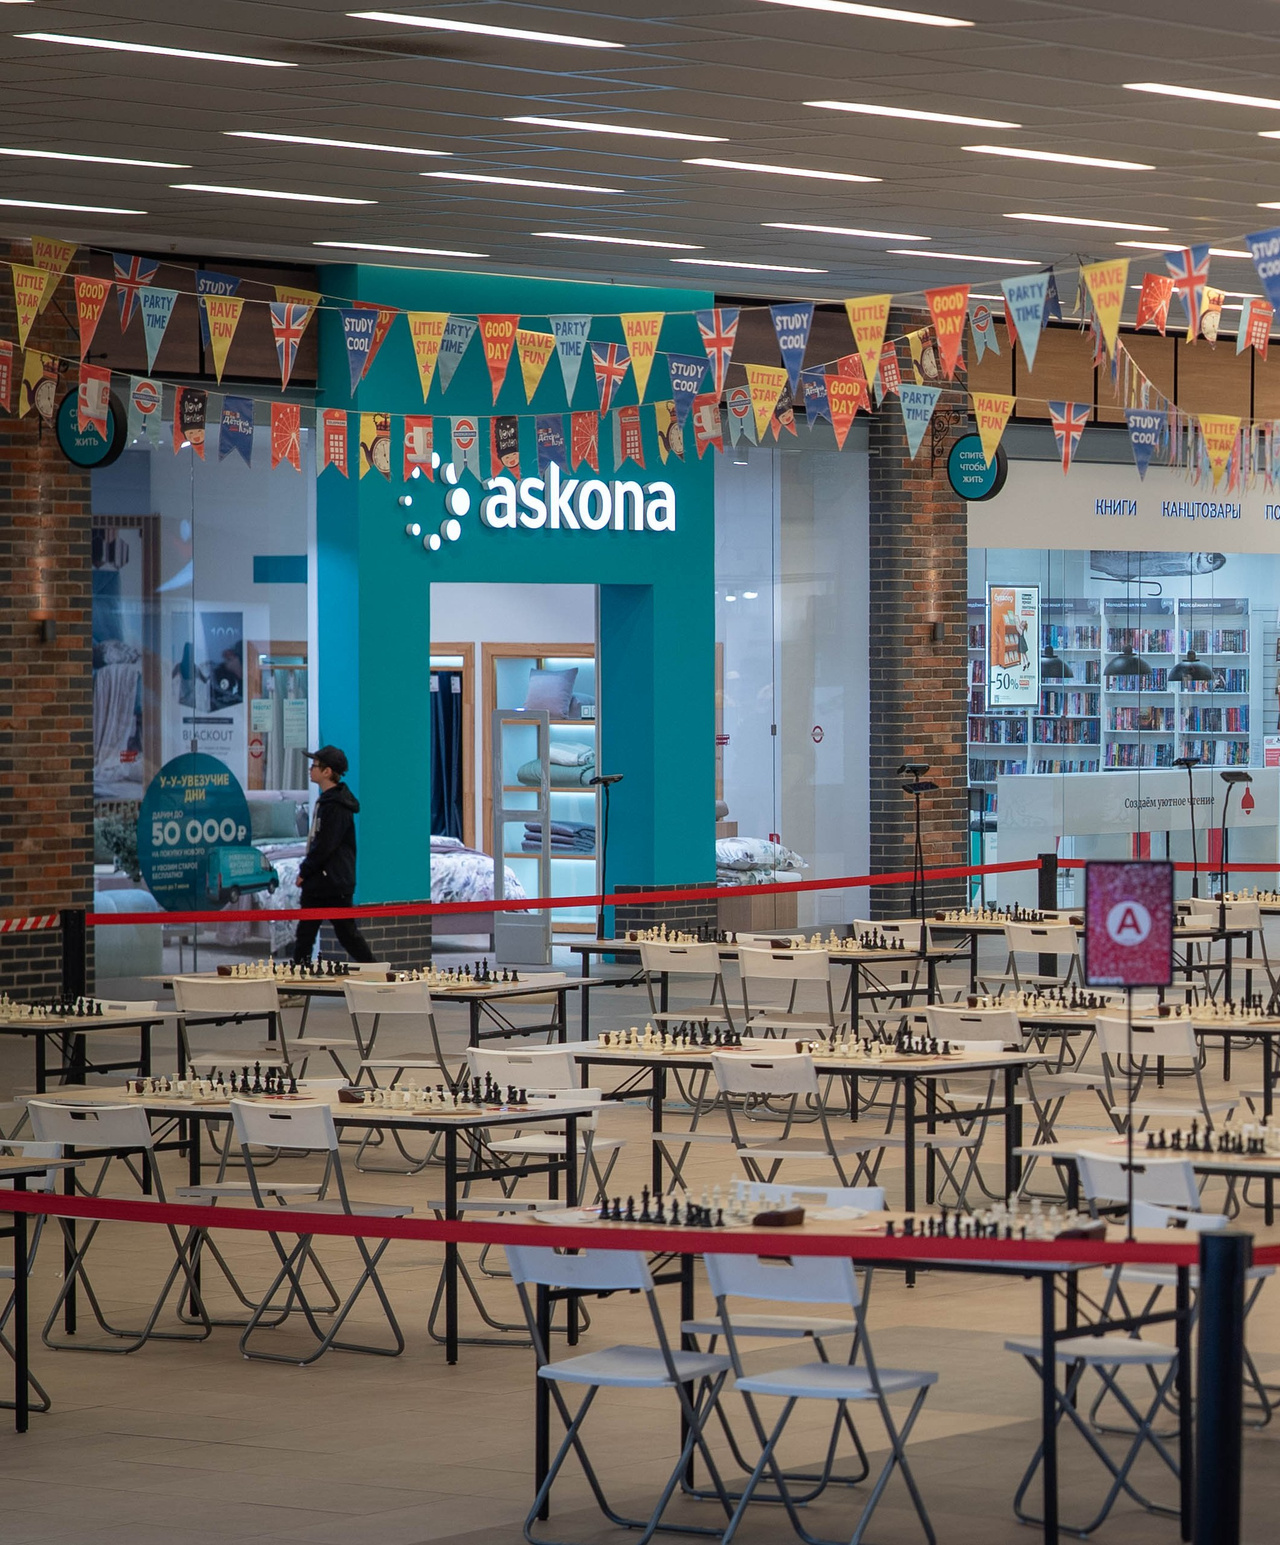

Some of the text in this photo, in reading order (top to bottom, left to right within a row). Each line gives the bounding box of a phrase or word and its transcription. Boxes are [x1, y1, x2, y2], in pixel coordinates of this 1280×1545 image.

[35, 242, 71, 261] HAVE
[16, 274, 44, 291] LITTLE
[1090, 266, 1124, 289] HAVE
[79, 282, 105, 300] GOOD
[199, 279, 233, 295] STUDY
[1008, 282, 1044, 303] PARTY
[17, 292, 39, 308] STAR
[143, 294, 173, 311] PARTY
[933, 292, 964, 314] GOOD
[1097, 290, 1121, 309] FUN
[80, 302, 100, 321] DAY
[210, 301, 238, 320] HAVE
[851, 304, 885, 322] LITTLE
[1015, 304, 1041, 322] TIME
[147, 313, 167, 330] TIME
[344, 317, 374, 333] STUDY
[413, 321, 442, 336] LITTLE
[485, 321, 513, 338] GOOD
[555, 321, 587, 336] PARTY
[627, 320, 658, 336] HAVE
[775, 313, 809, 331] STUDY
[937, 316, 962, 336] DAY
[212, 322, 232, 338] FUN
[443, 322, 471, 338] ARTY
[856, 326, 883, 342] STAR
[347, 337, 369, 352] COOL
[416, 341, 438, 355] STAR
[519, 332, 552, 349] HAVE
[560, 341, 582, 356] TIME
[780, 335, 806, 349] COOL
[487, 343, 510, 360] DAY
[523, 350, 546, 365] FUN
[632, 342, 653, 357] FUN
[671, 362, 703, 378] STUDY
[672, 379, 698, 394] COOL
[751, 372, 783, 387] LITTLE
[752, 388, 778, 401] STAR
[830, 381, 860, 397] GOOD
[832, 398, 856, 414] DAY
[902, 392, 936, 406] PARTY
[977, 398, 1009, 414] HAVE
[906, 408, 928, 422] TIME
[981, 415, 1003, 430] FUN
[1128, 415, 1161, 430] STUDY
[1204, 422, 1236, 436] LITTLE
[75, 438, 99, 447] жить
[1131, 431, 1157, 445] COOL
[1206, 438, 1231, 451] STAR
[960, 463, 986, 472] чтобы
[963, 475, 983, 483] жить
[481, 461, 676, 531] askona
[1095, 499, 1137, 516] КНИГИ
[1161, 501, 1242, 520] КАНЦТОВАРЫ
[183, 730, 233, 741] BLACKOUT
[160, 773, 229, 788] У-У-УВЕЗУЧИЕ
[184, 789, 206, 803] ДНИ
[1124, 796, 1215, 810] Создаём уютное чтение
[152, 810, 184, 821] ДАРИМ ДО
[152, 820, 181, 846] 50
[1116, 908, 1142, 934] A
